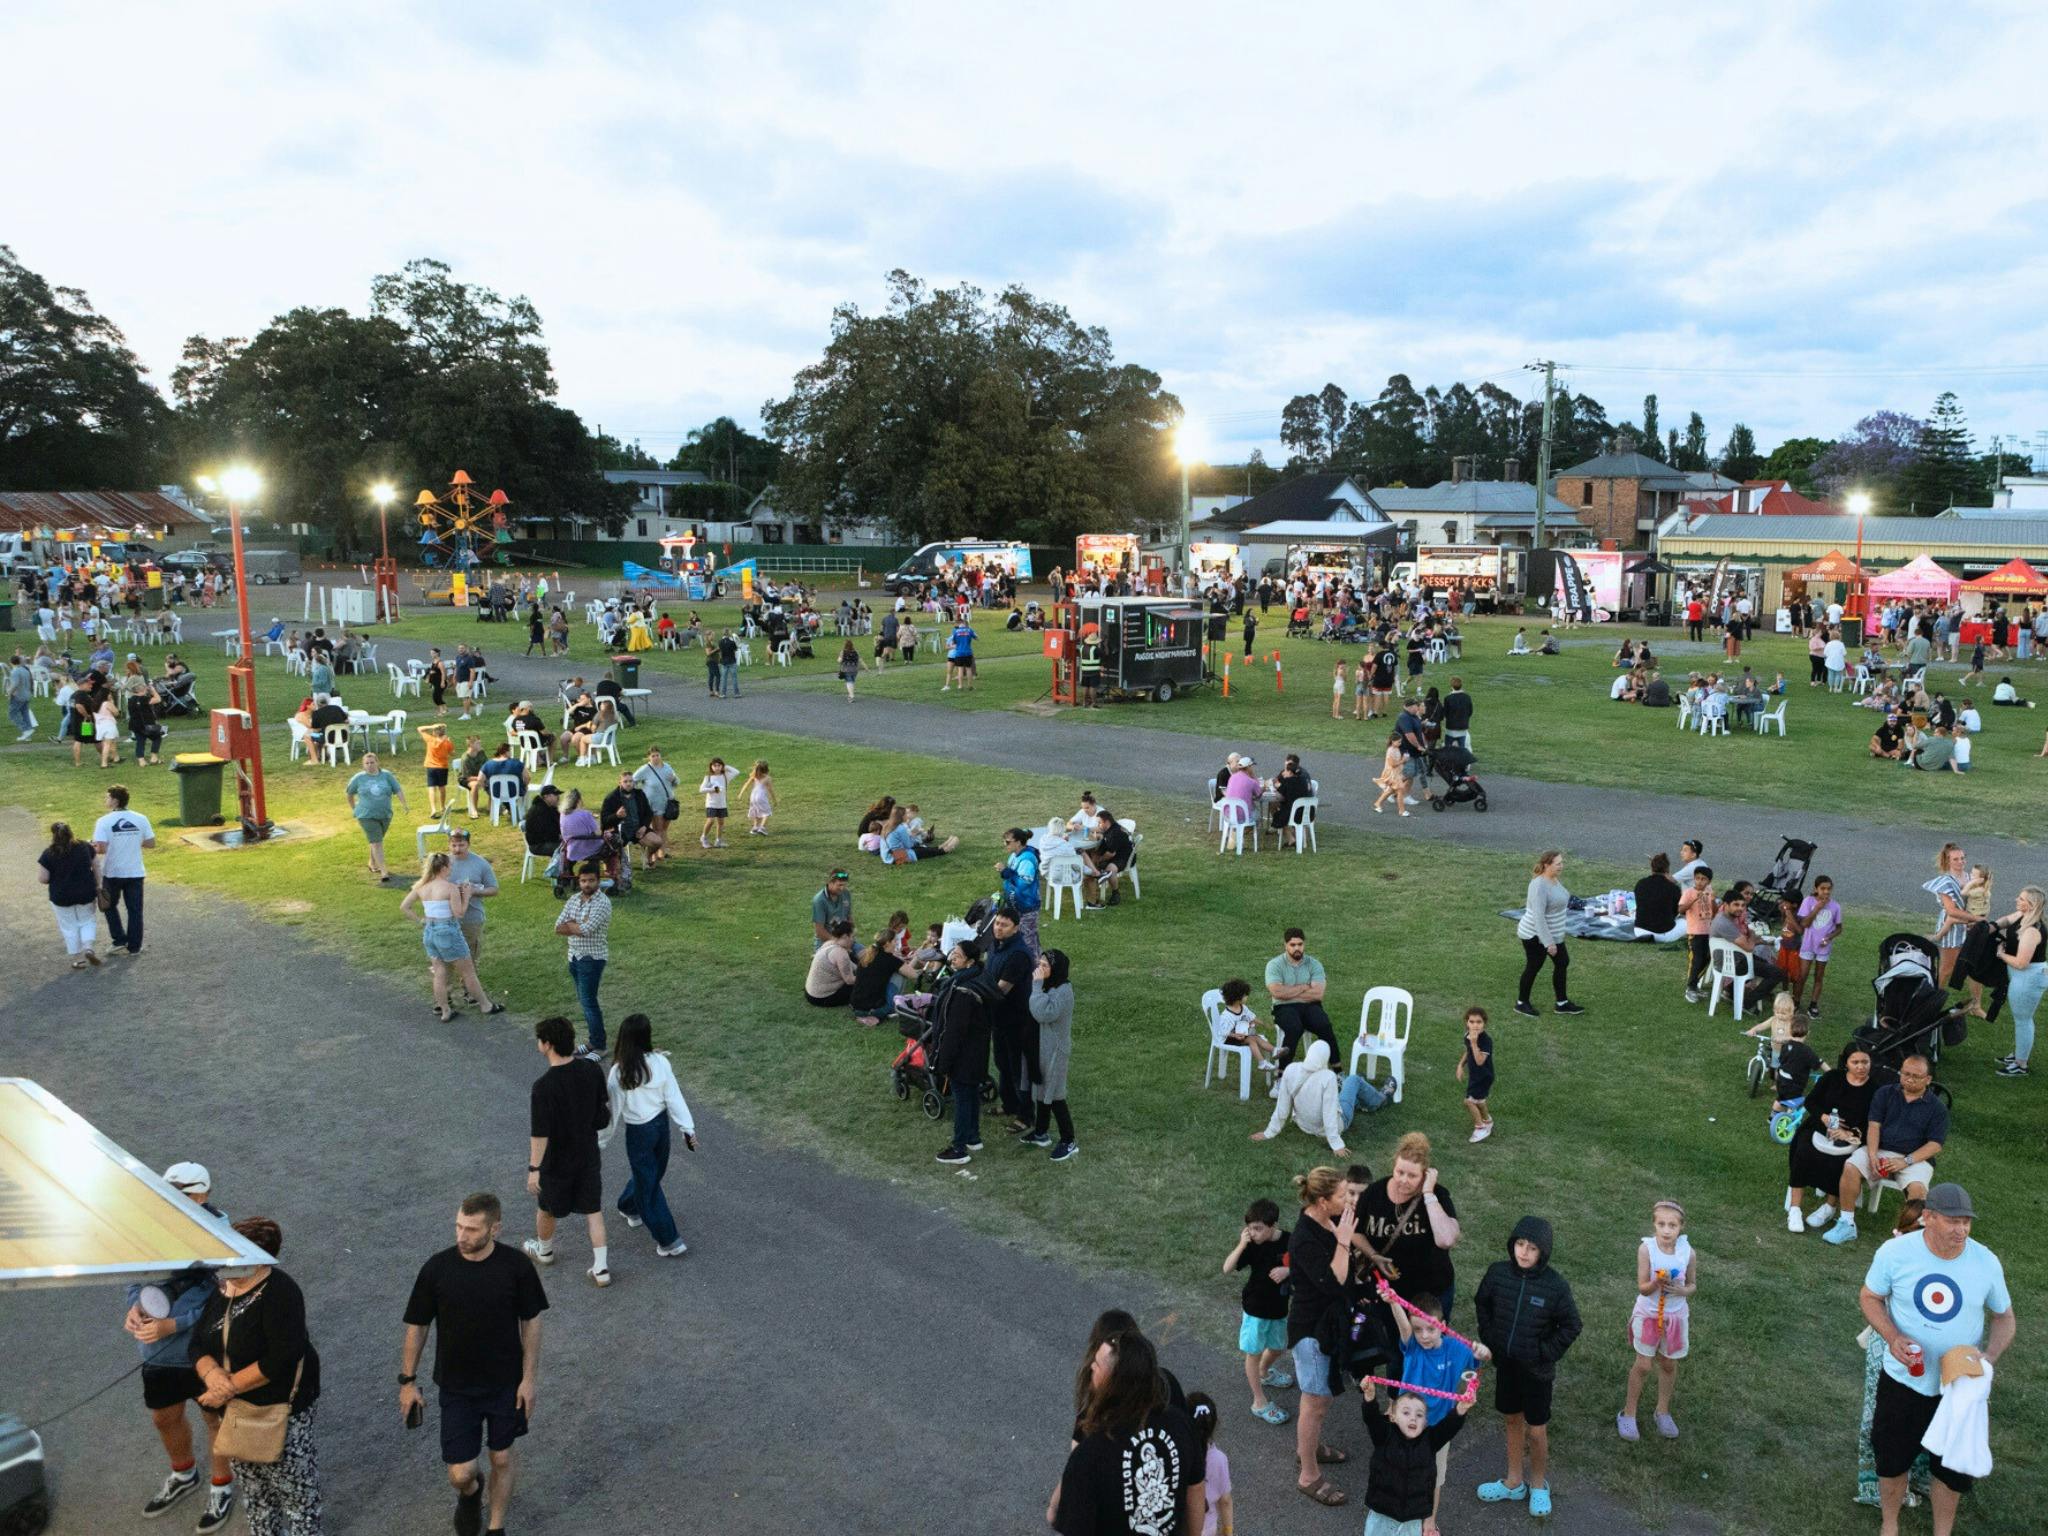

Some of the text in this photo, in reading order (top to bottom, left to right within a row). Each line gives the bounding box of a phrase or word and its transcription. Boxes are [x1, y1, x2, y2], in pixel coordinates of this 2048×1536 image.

[1463, 576, 1493, 588] SACKS
[1565, 567, 1580, 608] FRAPPE
[1366, 1214, 1426, 1237] Meci.
[1122, 1428, 1180, 1511] EXPLORE AND DISCOVER
